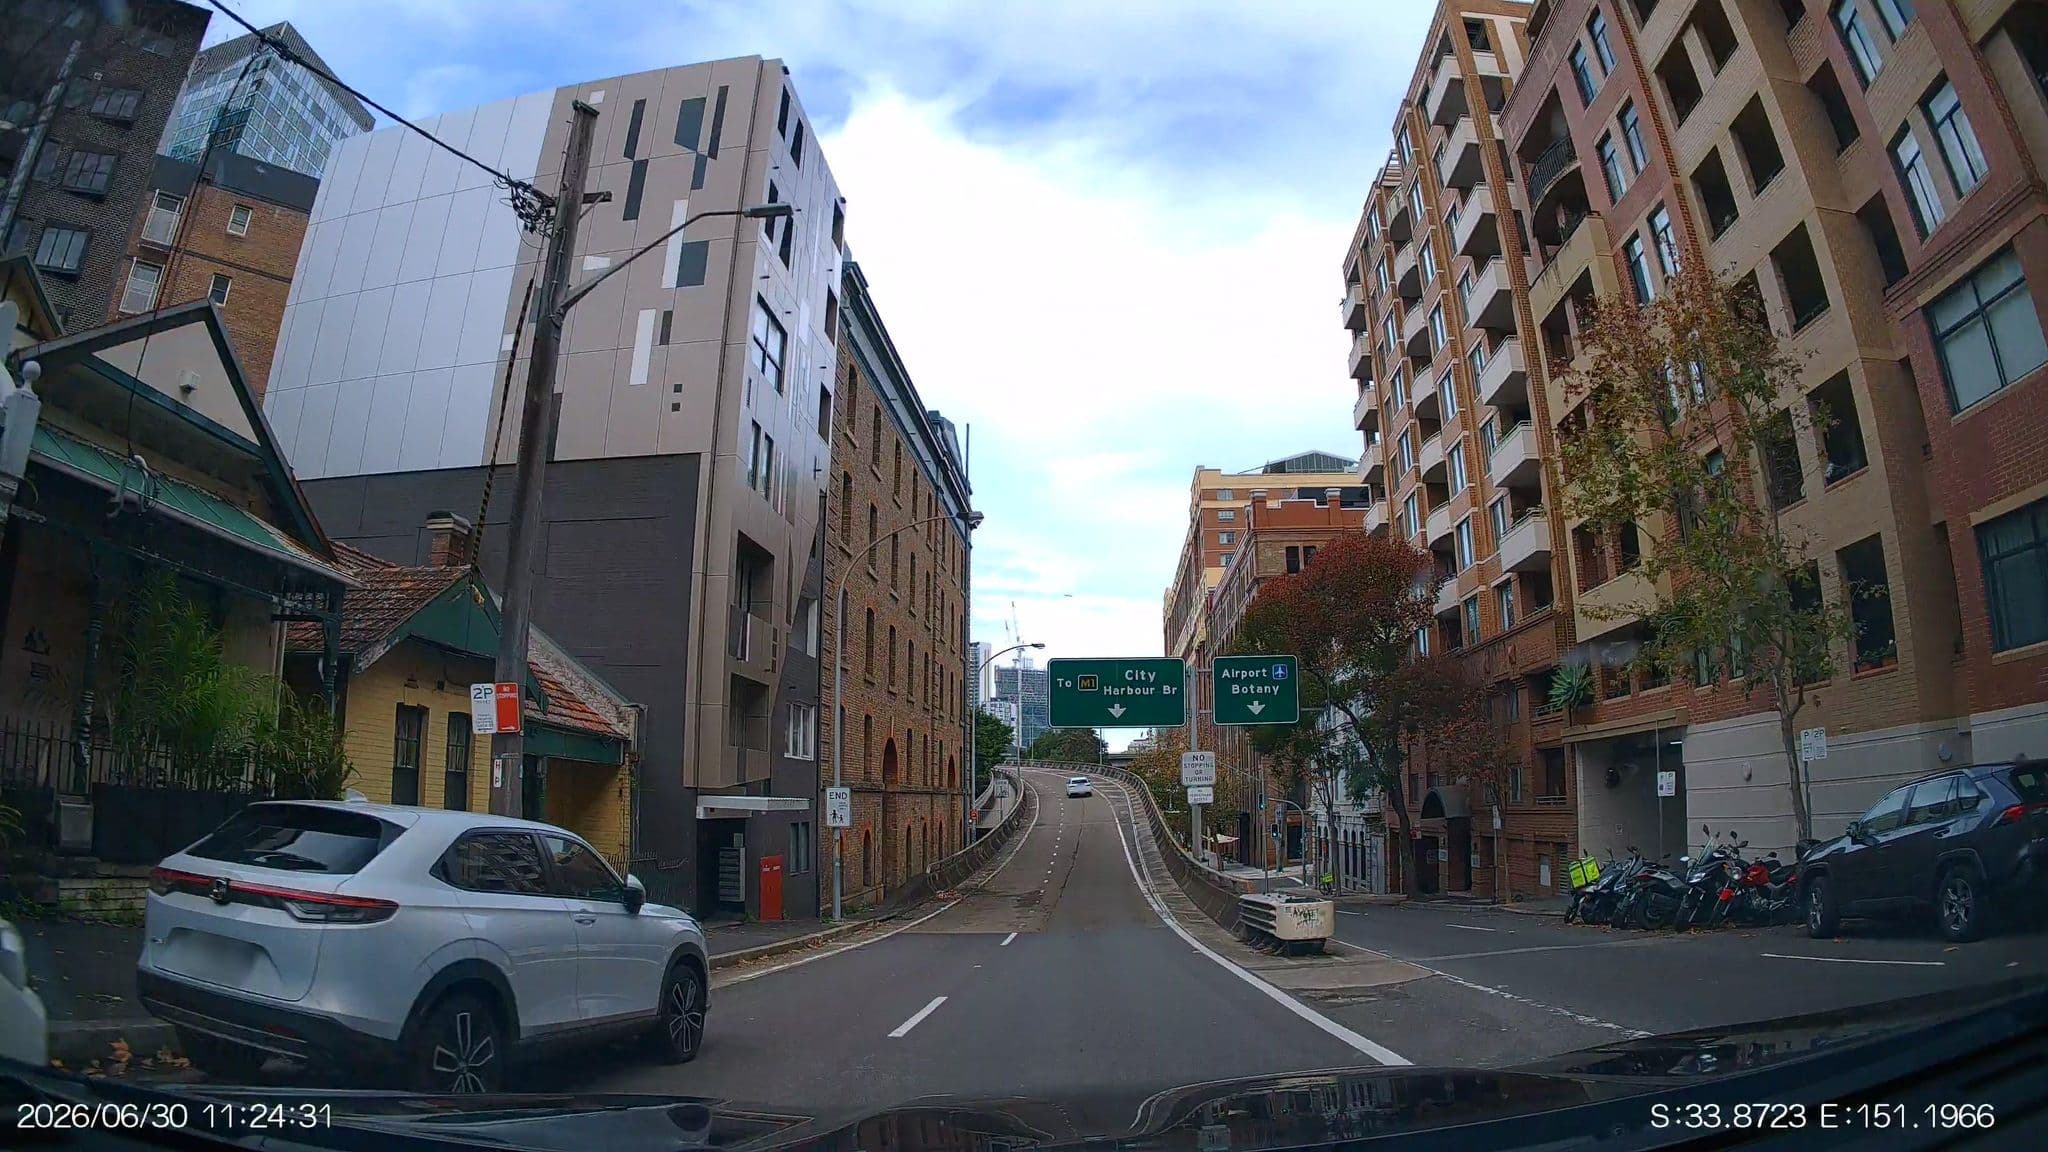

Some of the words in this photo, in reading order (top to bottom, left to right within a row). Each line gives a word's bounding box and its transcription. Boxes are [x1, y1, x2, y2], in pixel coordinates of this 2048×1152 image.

[1125, 669, 1156, 682] City
[1221, 668, 1267, 680] Airport
[1057, 678, 1072, 688] To
[1081, 679, 1095, 688] M1
[473, 687, 493, 699] 2P
[1103, 685, 1155, 695] Harbour
[1162, 685, 1177, 695] Br
[1231, 684, 1279, 696] Botany
[829, 791, 848, 800] END
